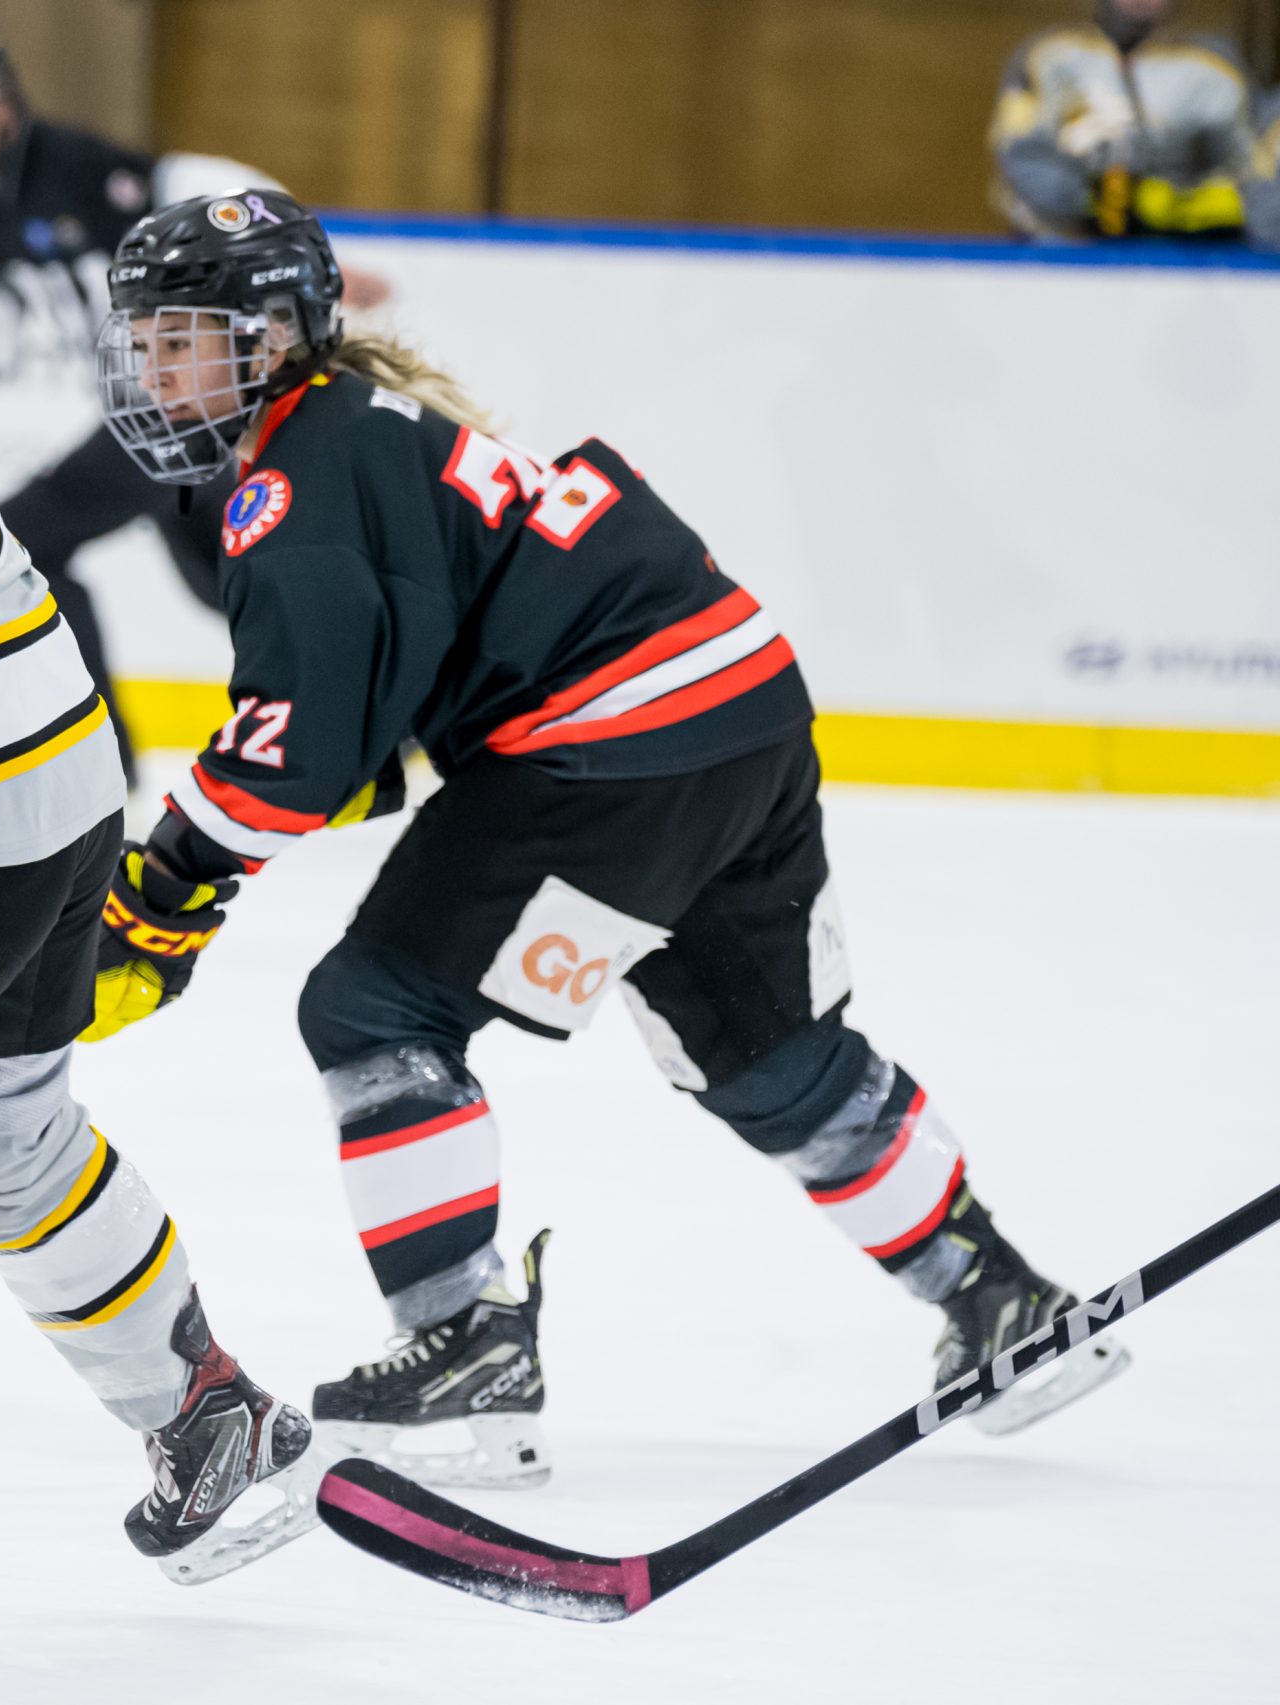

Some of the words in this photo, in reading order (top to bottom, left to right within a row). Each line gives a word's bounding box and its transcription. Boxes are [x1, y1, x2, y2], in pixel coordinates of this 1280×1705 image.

[251, 265, 300, 286] CCM
[916, 1269, 1145, 1436] CCM
[470, 1354, 533, 1411] CCM
[193, 1466, 220, 1515] CCM
